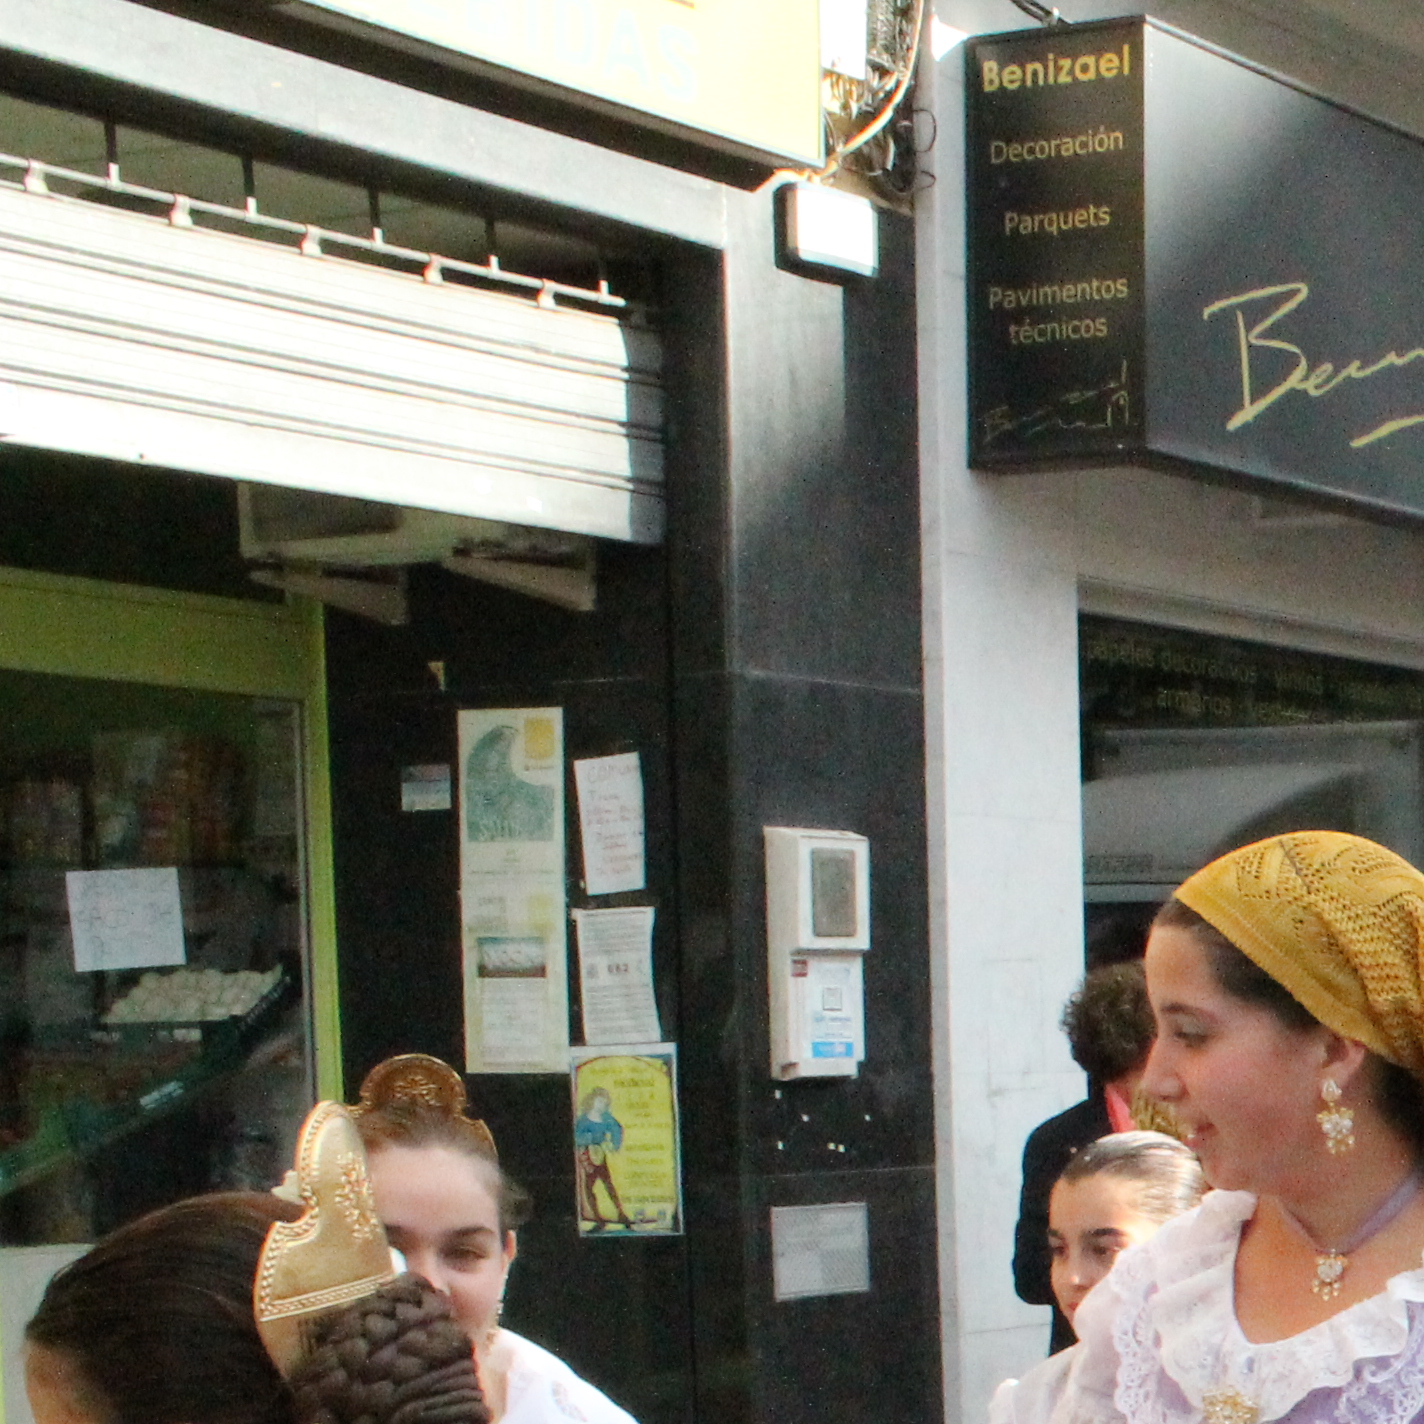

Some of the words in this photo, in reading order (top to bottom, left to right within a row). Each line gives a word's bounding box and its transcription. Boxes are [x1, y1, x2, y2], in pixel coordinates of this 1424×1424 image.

[982, 44, 1131, 92] Benizael
[990, 125, 1123, 164] Decoración
[1004, 204, 1112, 236] Parquets
[988, 278, 1129, 309] Pavimentos
[1008, 317, 1109, 345] técnicos
